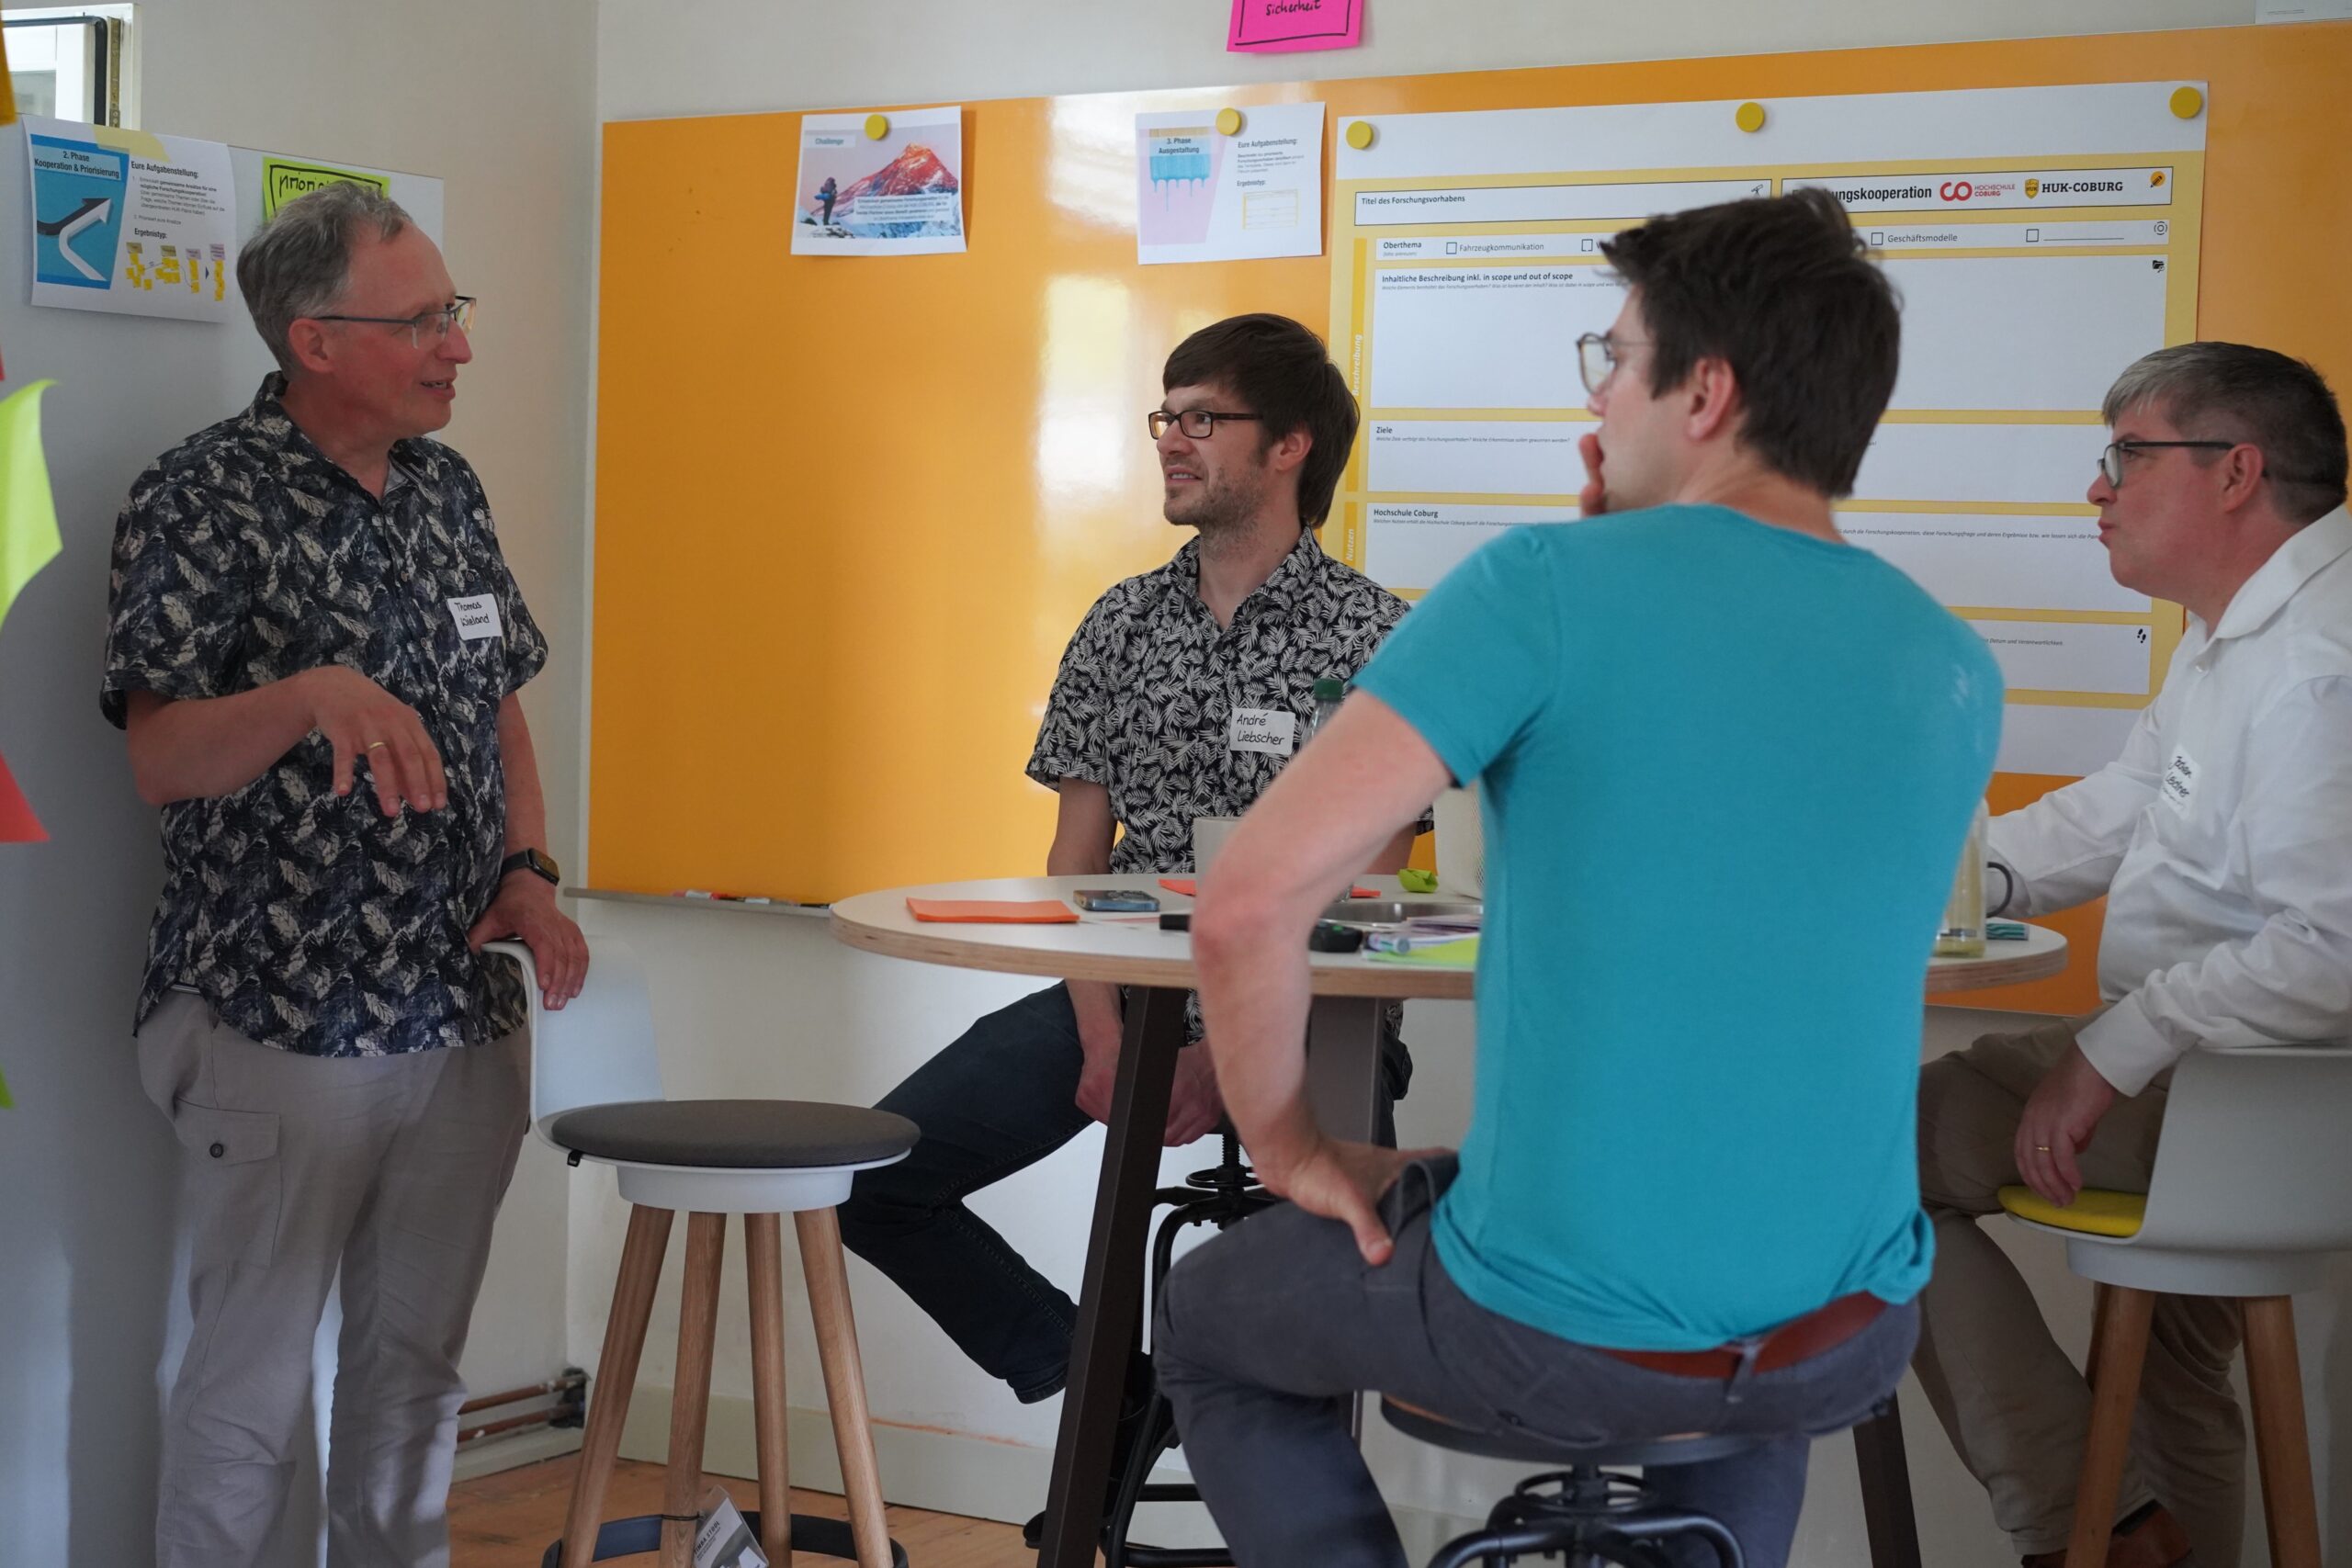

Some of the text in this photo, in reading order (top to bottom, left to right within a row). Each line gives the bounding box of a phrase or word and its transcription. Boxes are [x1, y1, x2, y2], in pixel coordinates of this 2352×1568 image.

[1159, 146, 1200, 154] Ausgestaltung
[62, 151, 90, 163] 2. Phase
[34, 158, 120, 179] Kooperation & Priorisierung
[130, 161, 199, 179] Eure Aufgabenstellung:
[2041, 181, 2123, 194] HUK-COBURG
[1392, 195, 1465, 205] Forschungsvorhabens
[134, 227, 167, 240] Ergebnistyp:
[1887, 233, 1958, 243] Geschäftsmodelle
[1459, 243, 1544, 253] Fahrzeugkommunikation
[1382, 275, 1417, 283] Inhaltliche
[1419, 275, 1465, 283] Beschreibung
[1351, 334, 1363, 397] Beschreibung
[1414, 510, 1439, 519] Coburg
[1346, 528, 1354, 561] Nutzen
[1237, 713, 1269, 726] André
[1238, 730, 1284, 745] Liebscher
